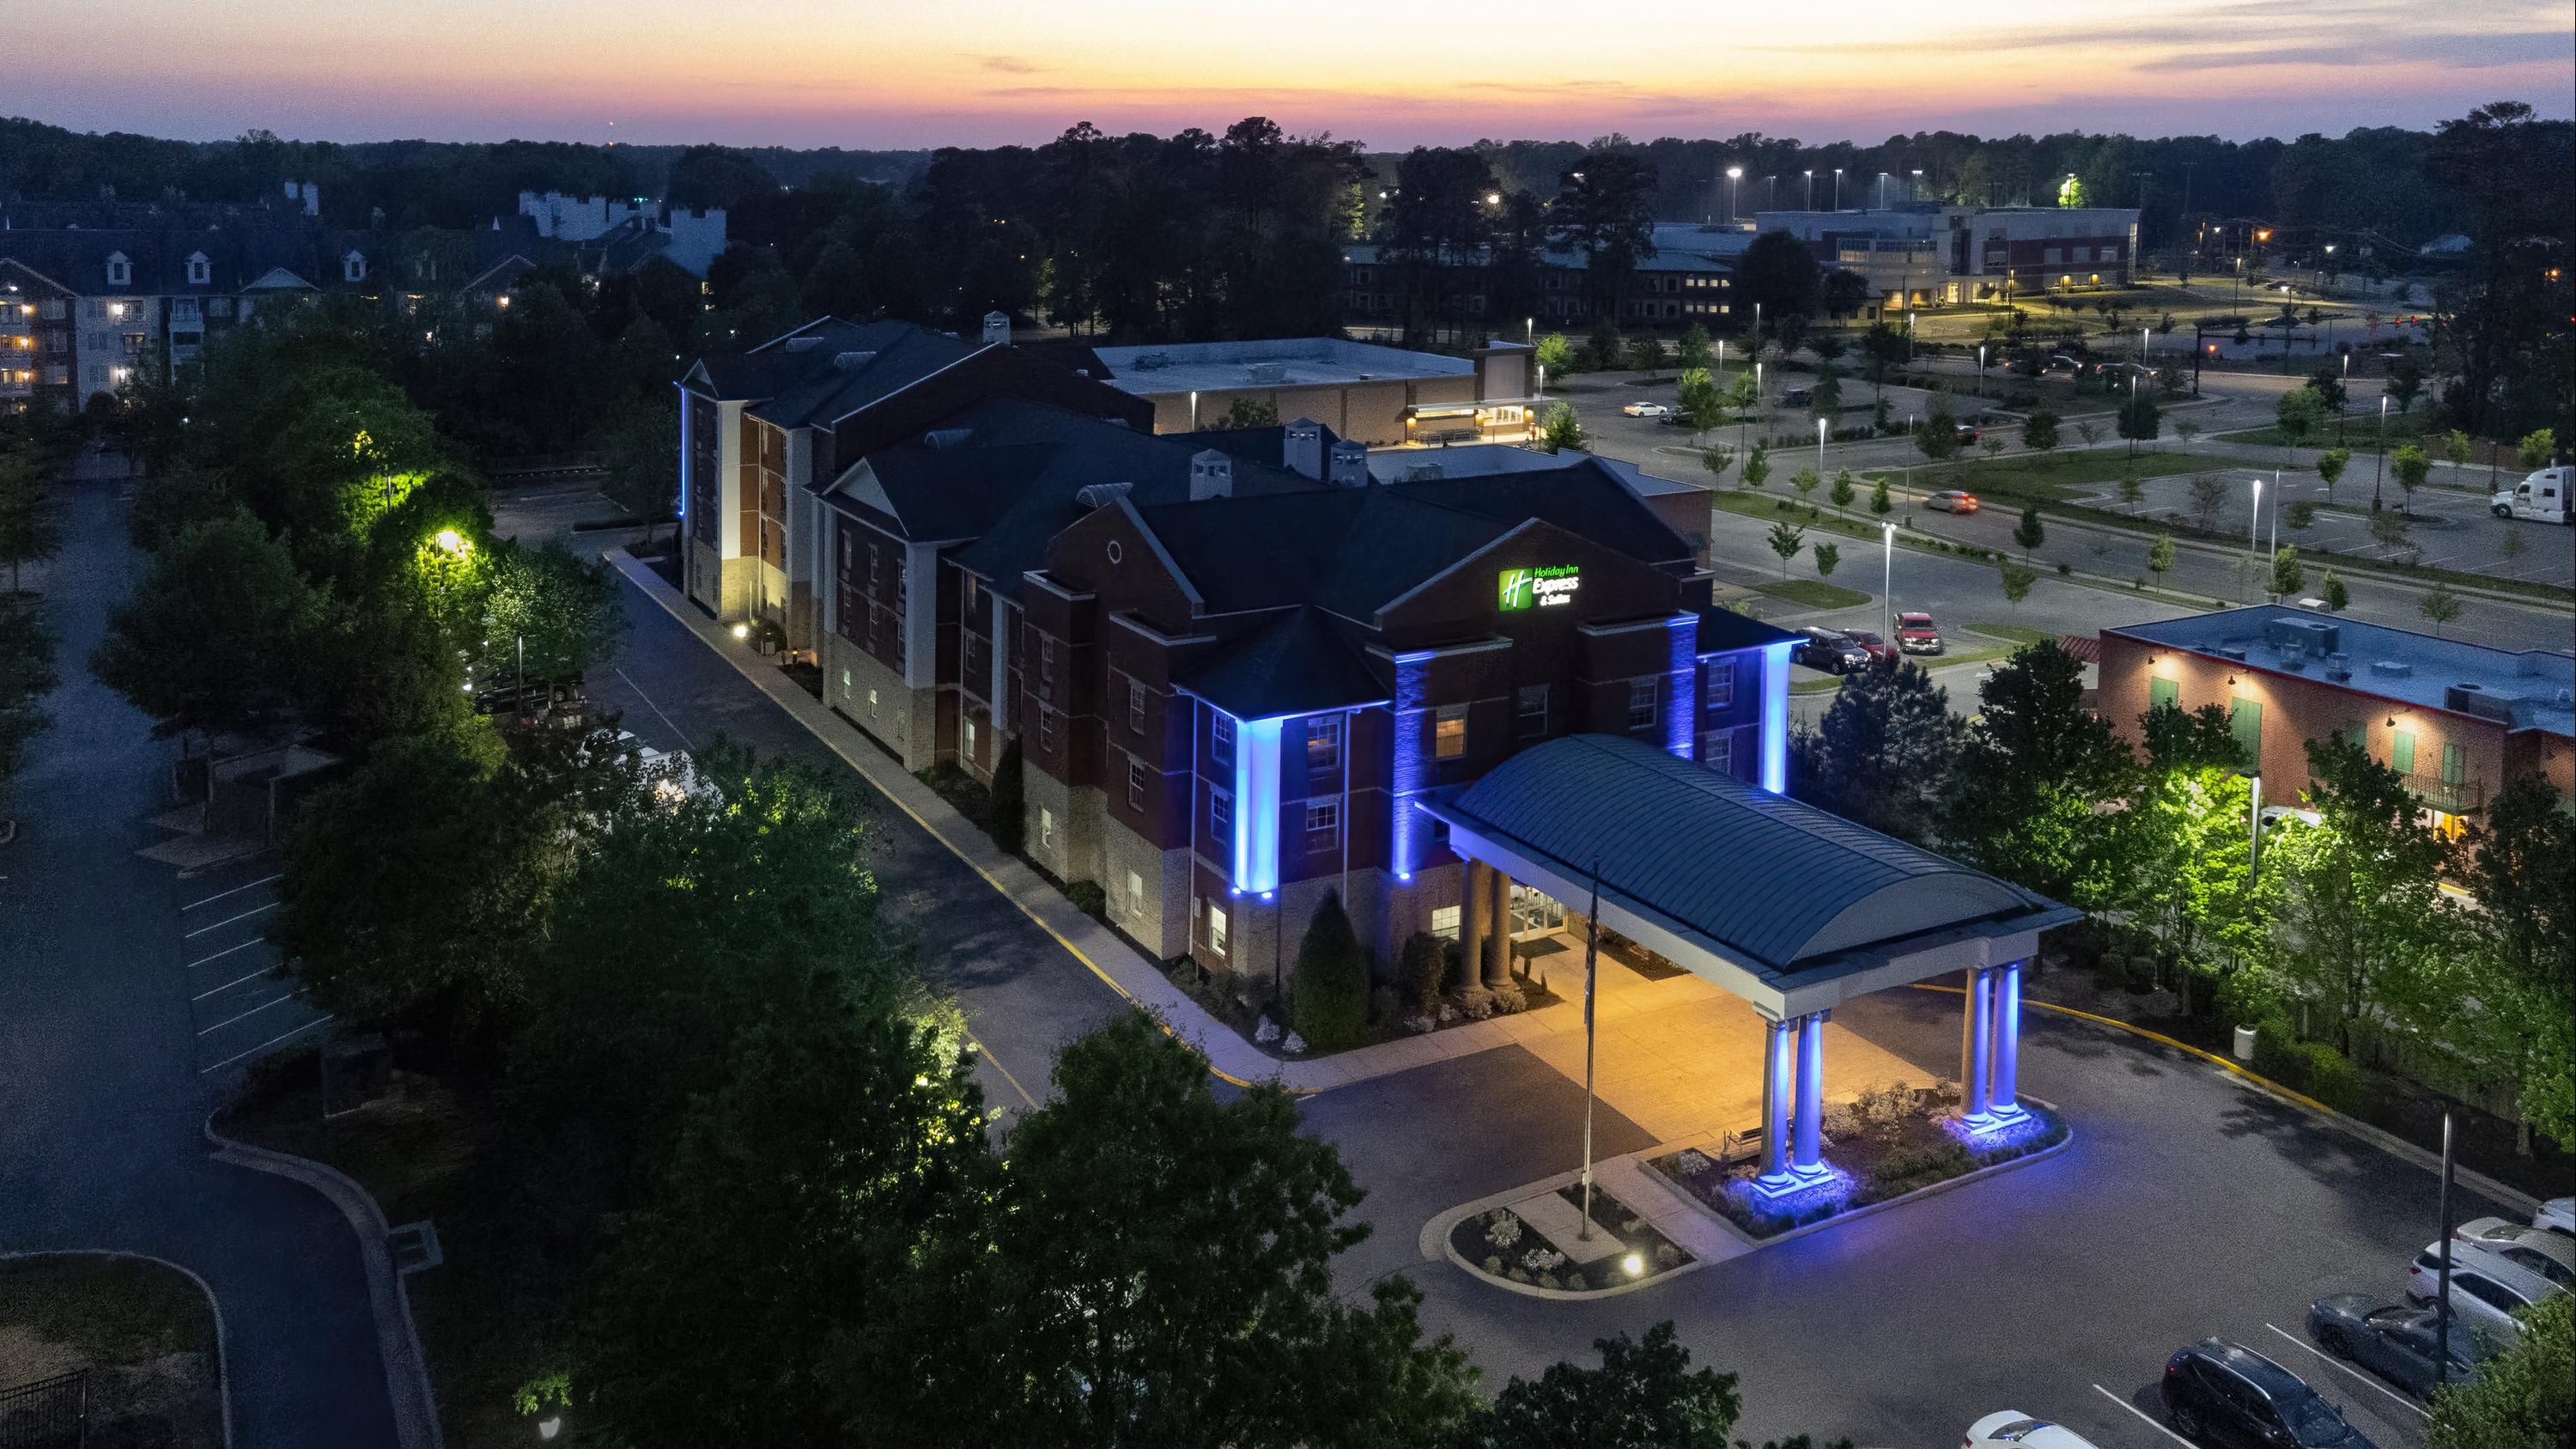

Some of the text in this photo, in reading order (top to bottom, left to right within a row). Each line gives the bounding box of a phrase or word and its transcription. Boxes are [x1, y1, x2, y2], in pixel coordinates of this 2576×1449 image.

[1534, 564, 1579, 577] Holiday Inn
[1533, 576, 1579, 595] Express
